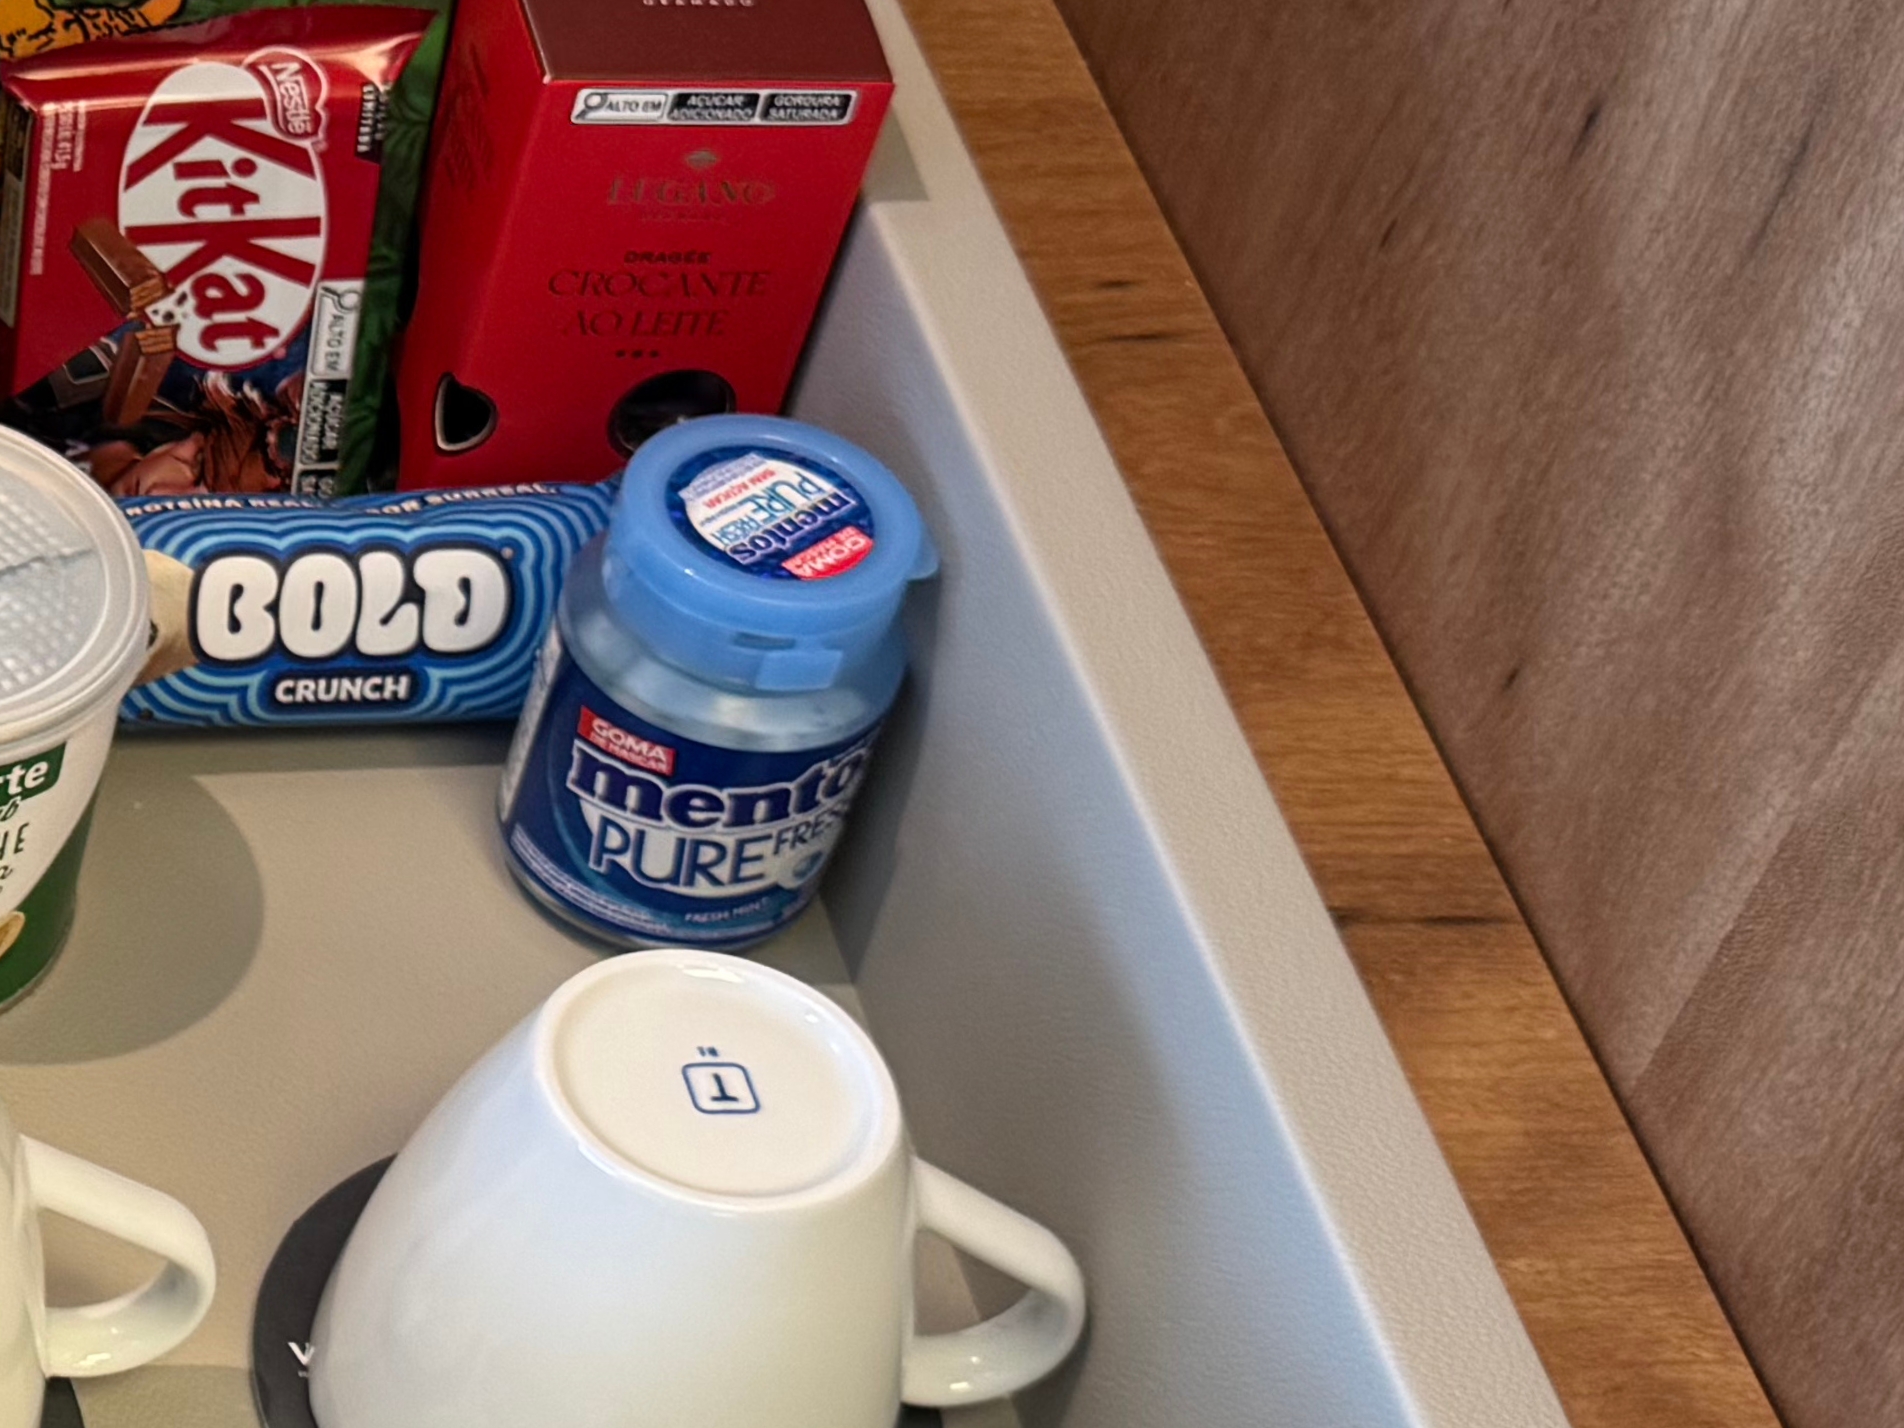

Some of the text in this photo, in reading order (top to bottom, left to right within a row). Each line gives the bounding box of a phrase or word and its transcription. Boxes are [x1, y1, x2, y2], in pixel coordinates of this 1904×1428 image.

[257, 61, 313, 136] Nestlé
[124, 97, 322, 353] KitKat
[548, 271, 770, 297] CROCANTE
[327, 314, 344, 349] ALTO
[563, 309, 730, 337] AO LEITE
[125, 498, 242, 518] ROTEÍNA
[728, 492, 854, 564] mentos
[195, 548, 508, 661] BOLD
[275, 674, 411, 704] CRUNCH
[593, 718, 667, 764] GOMA
[567, 739, 868, 830] mento
[592, 816, 774, 888] PURE
[773, 808, 845, 856] FRE
